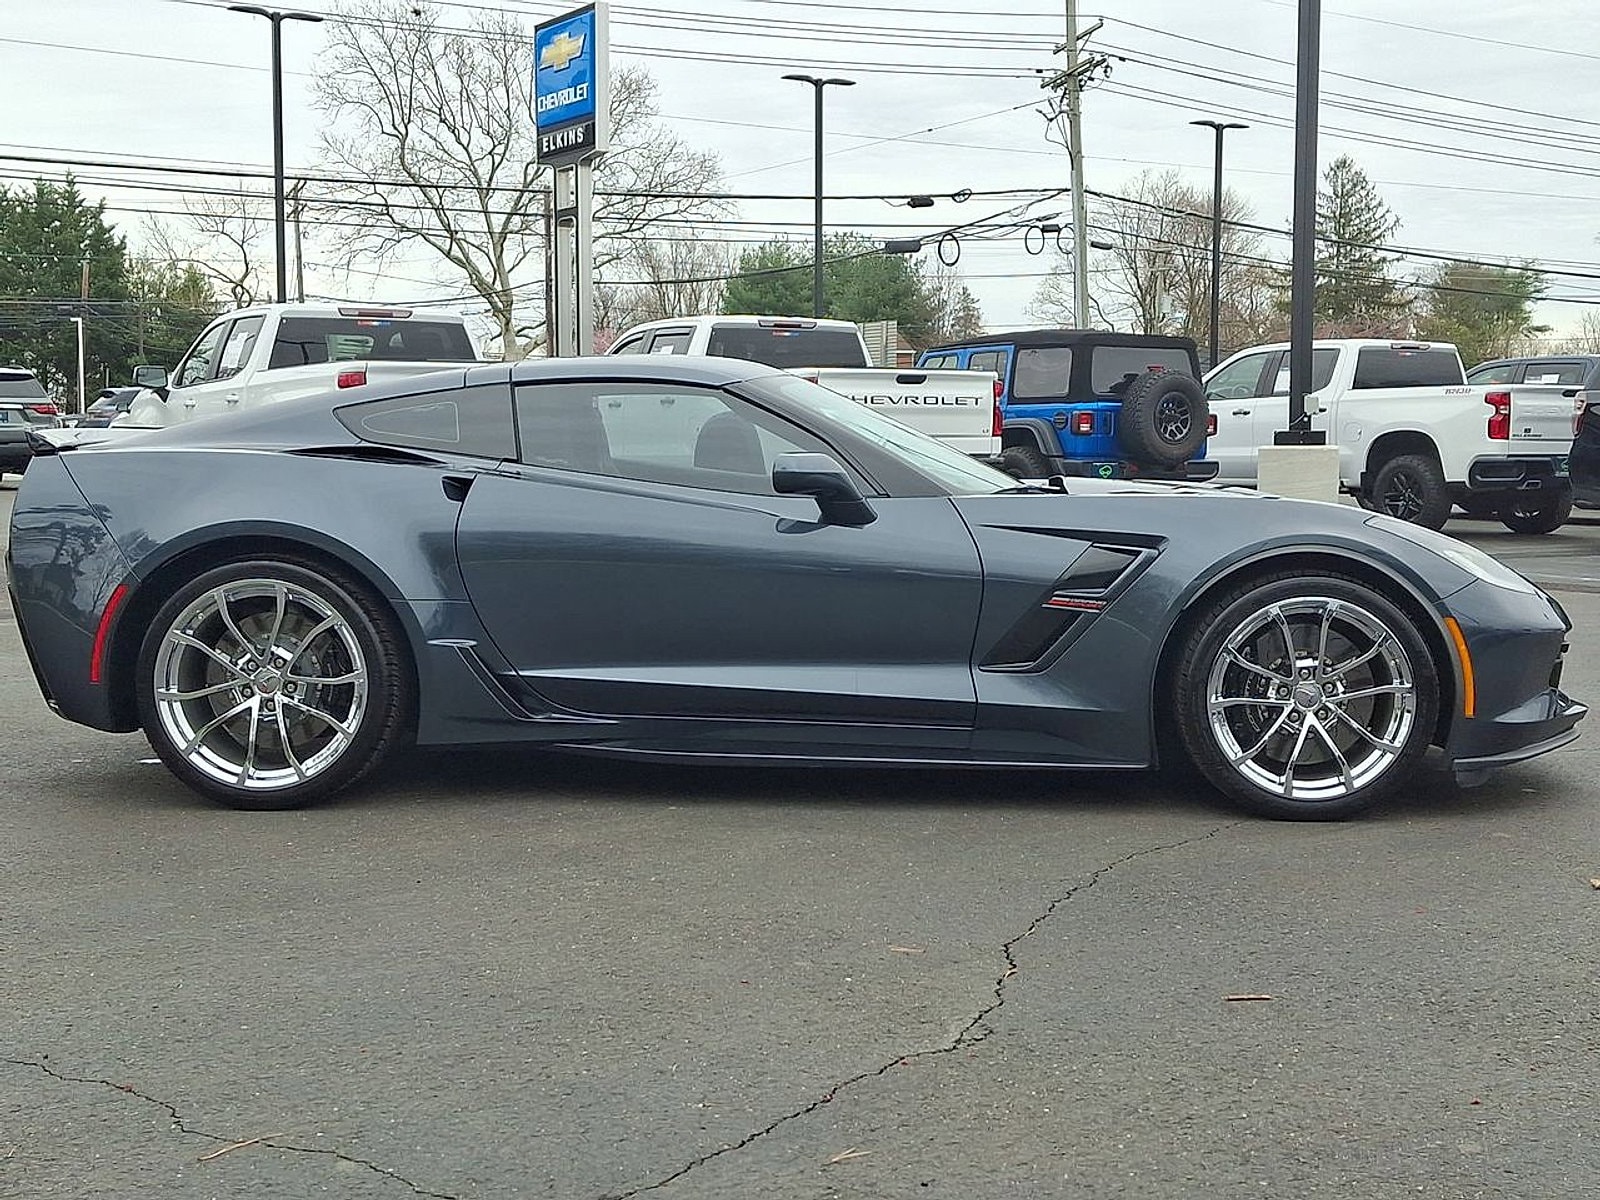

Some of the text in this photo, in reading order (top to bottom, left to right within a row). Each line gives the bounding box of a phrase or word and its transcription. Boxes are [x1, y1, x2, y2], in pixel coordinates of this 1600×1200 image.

[538, 83, 588, 112] CHEVROLET
[542, 128, 584, 152] ELKINS
[844, 395, 983, 406] HEVROLET
